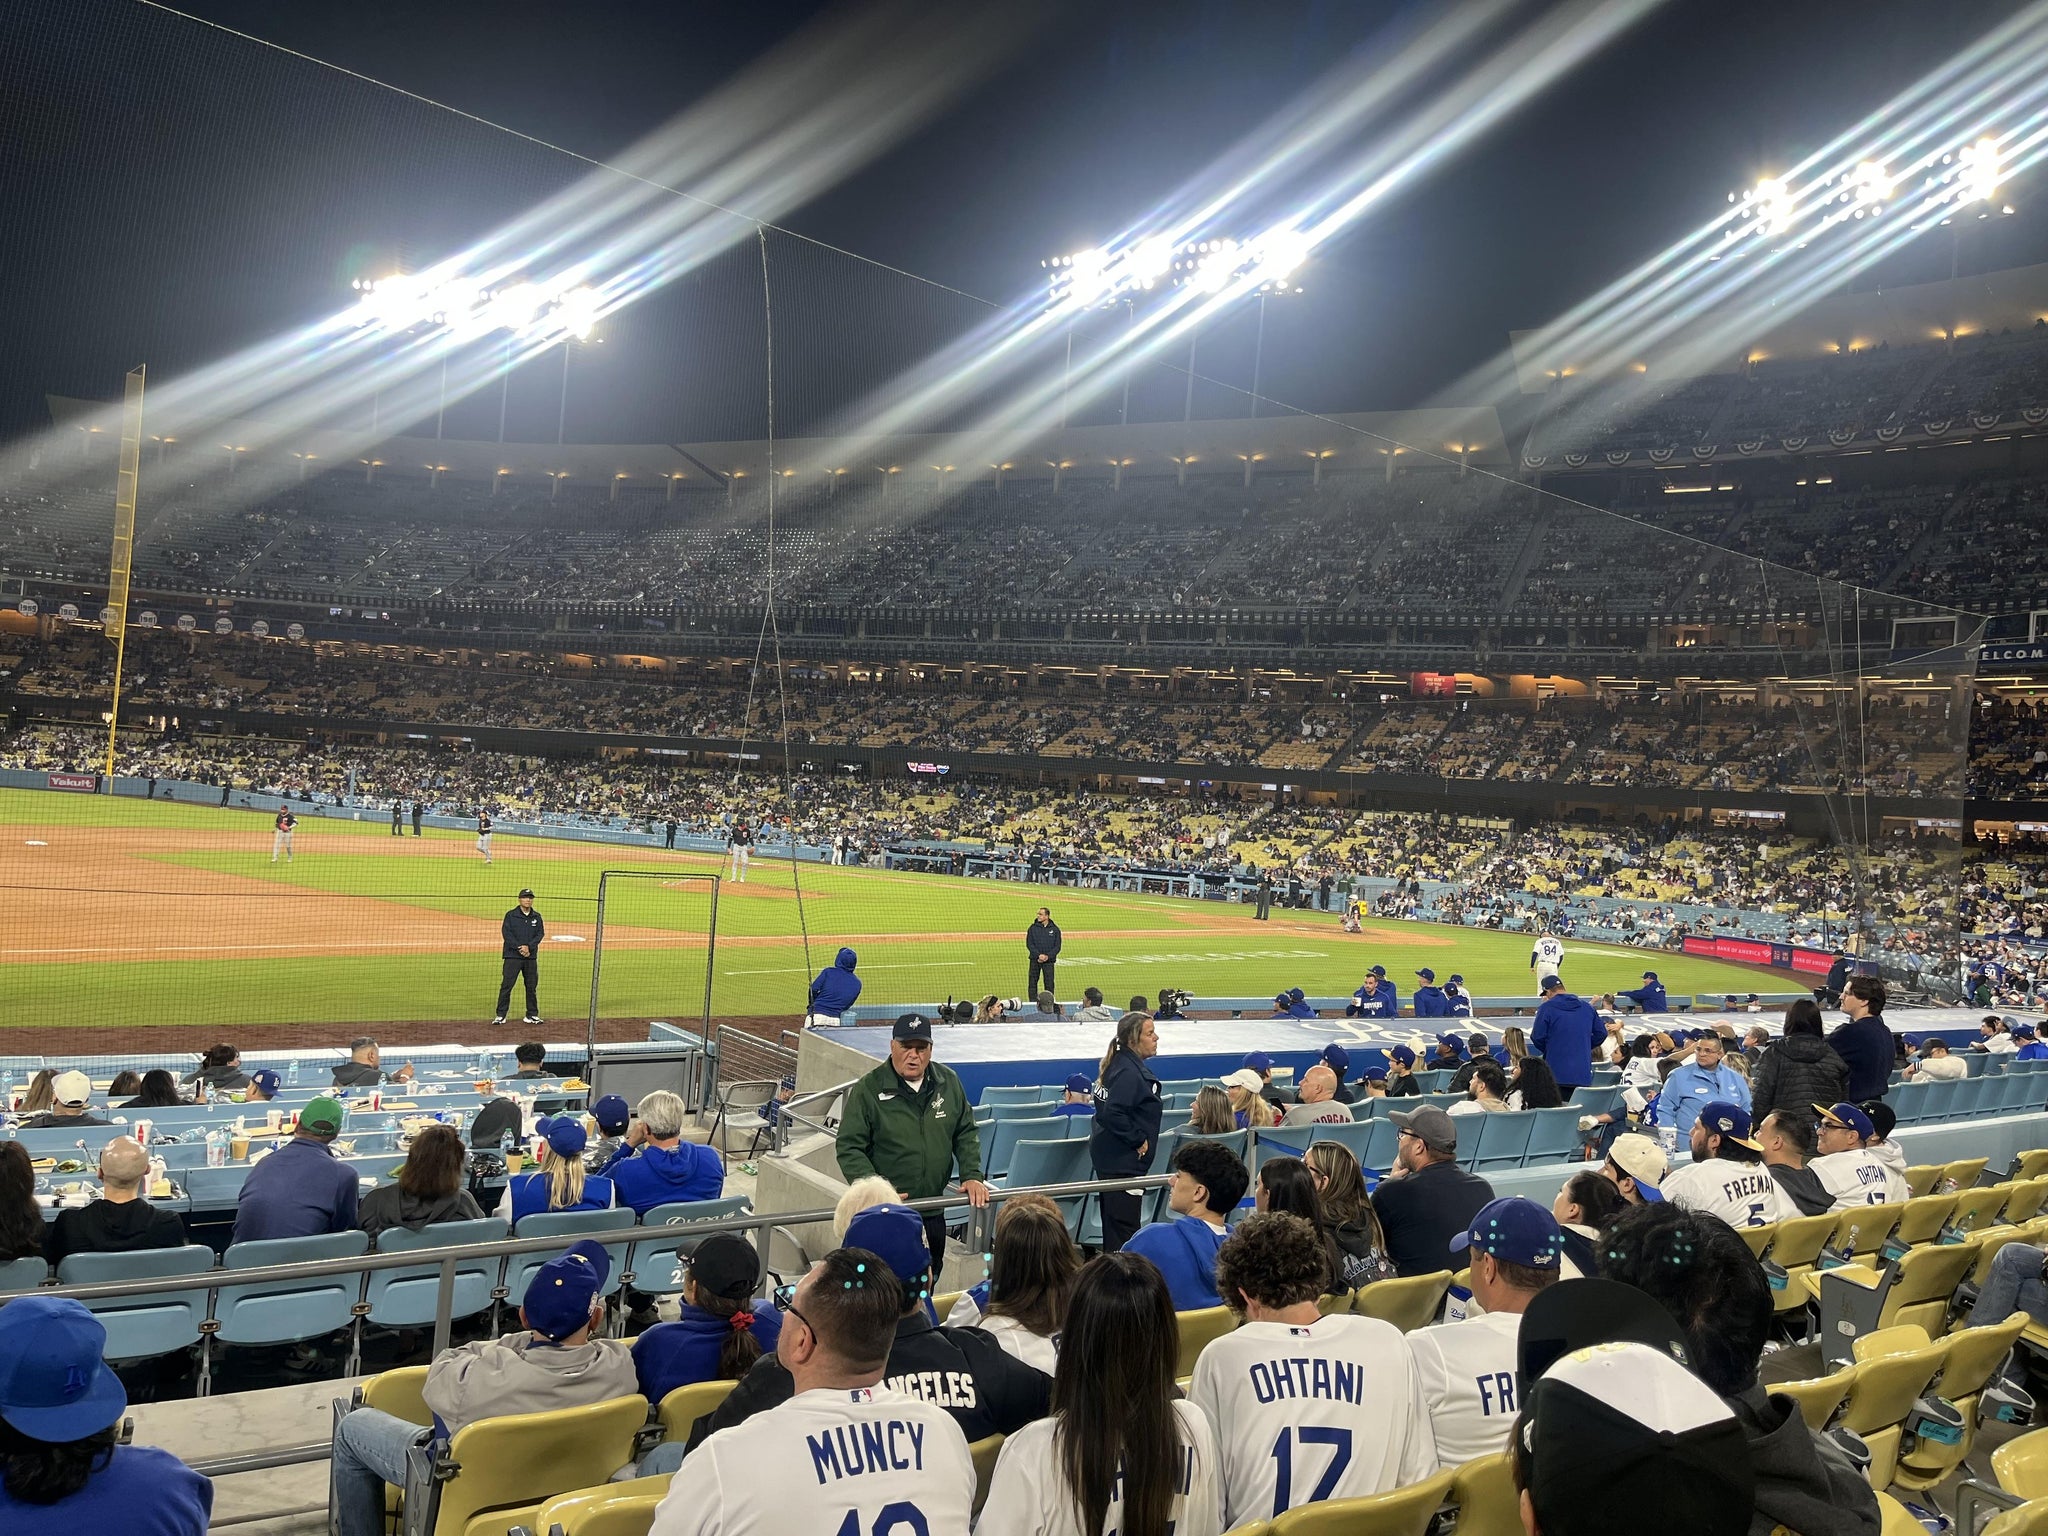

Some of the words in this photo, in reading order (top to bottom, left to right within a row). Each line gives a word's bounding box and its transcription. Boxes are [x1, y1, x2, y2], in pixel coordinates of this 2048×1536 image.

[51, 777, 93, 788] Yakult
[1544, 945, 1557, 956] 84
[1250, 1358, 1364, 1406] OHTANI
[806, 1420, 924, 1485] MUNCY
[1271, 1426, 1352, 1519] 17
